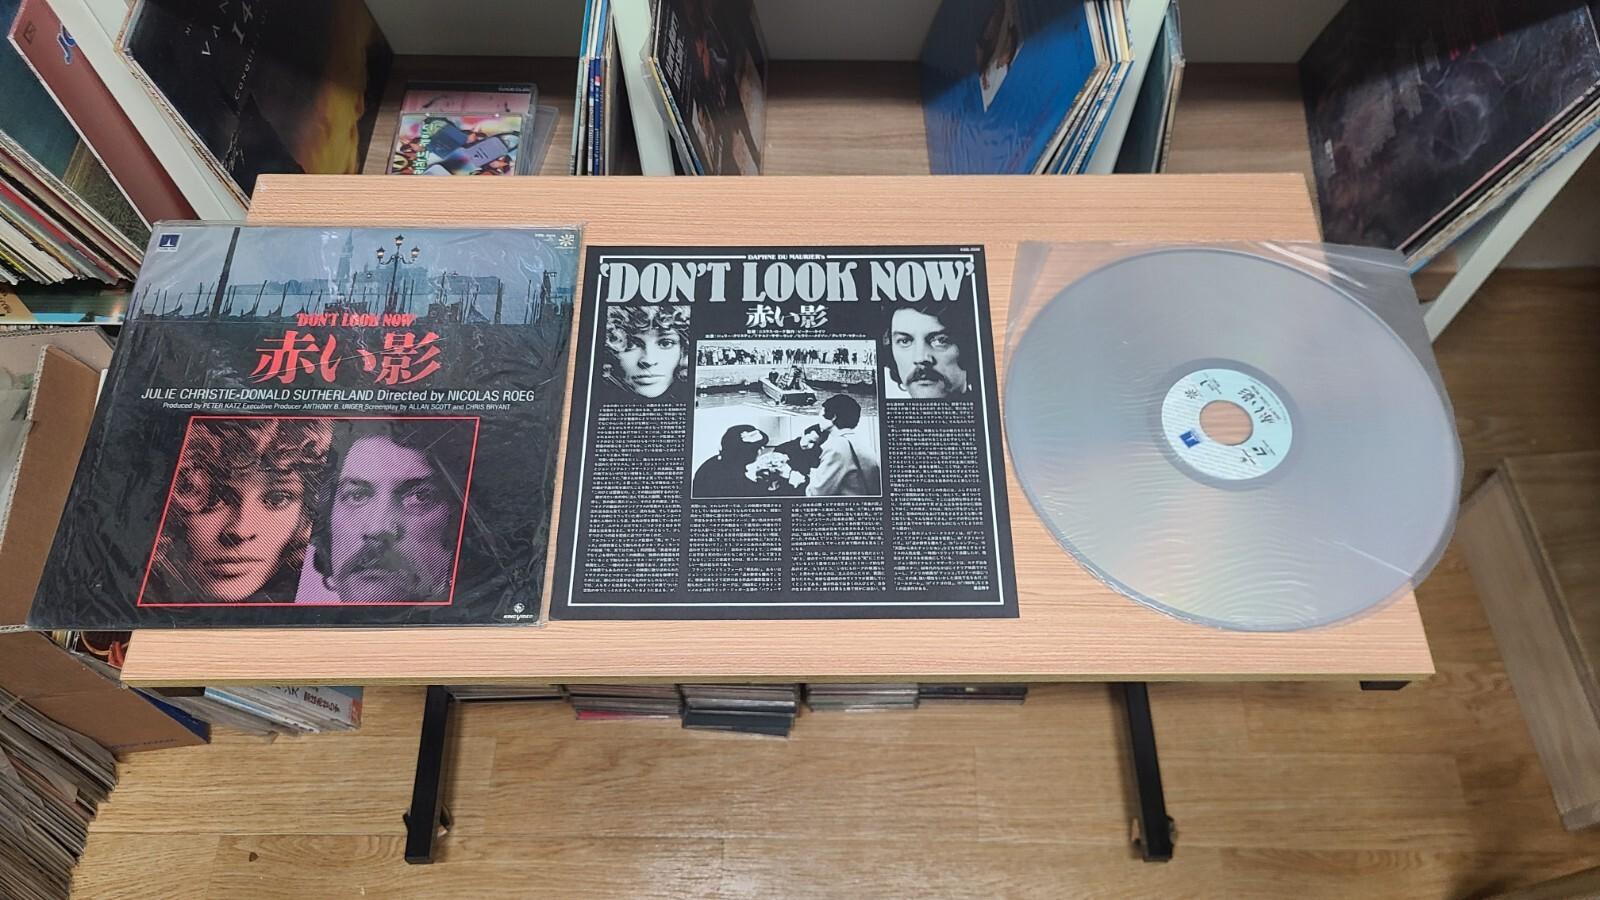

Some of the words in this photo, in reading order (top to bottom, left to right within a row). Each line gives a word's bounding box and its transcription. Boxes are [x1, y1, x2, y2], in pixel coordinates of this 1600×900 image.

[742, 261, 859, 302] LOOK
[341, 312, 379, 327] LOOK
[746, 304, 829, 328] 赤い影
[250, 330, 443, 386] 赤い影
[141, 388, 177, 399] JULIE
[293, 389, 373, 401] SUTHERLAND
[377, 390, 429, 401] Directed
[430, 390, 444, 403] by
[447, 390, 500, 401] NICOLAS
[503, 390, 535, 402] ROEG
[193, 402, 202, 410] by
[242, 402, 273, 410] Executive
[273, 402, 302, 410] Producer
[399, 404, 408, 412] by
